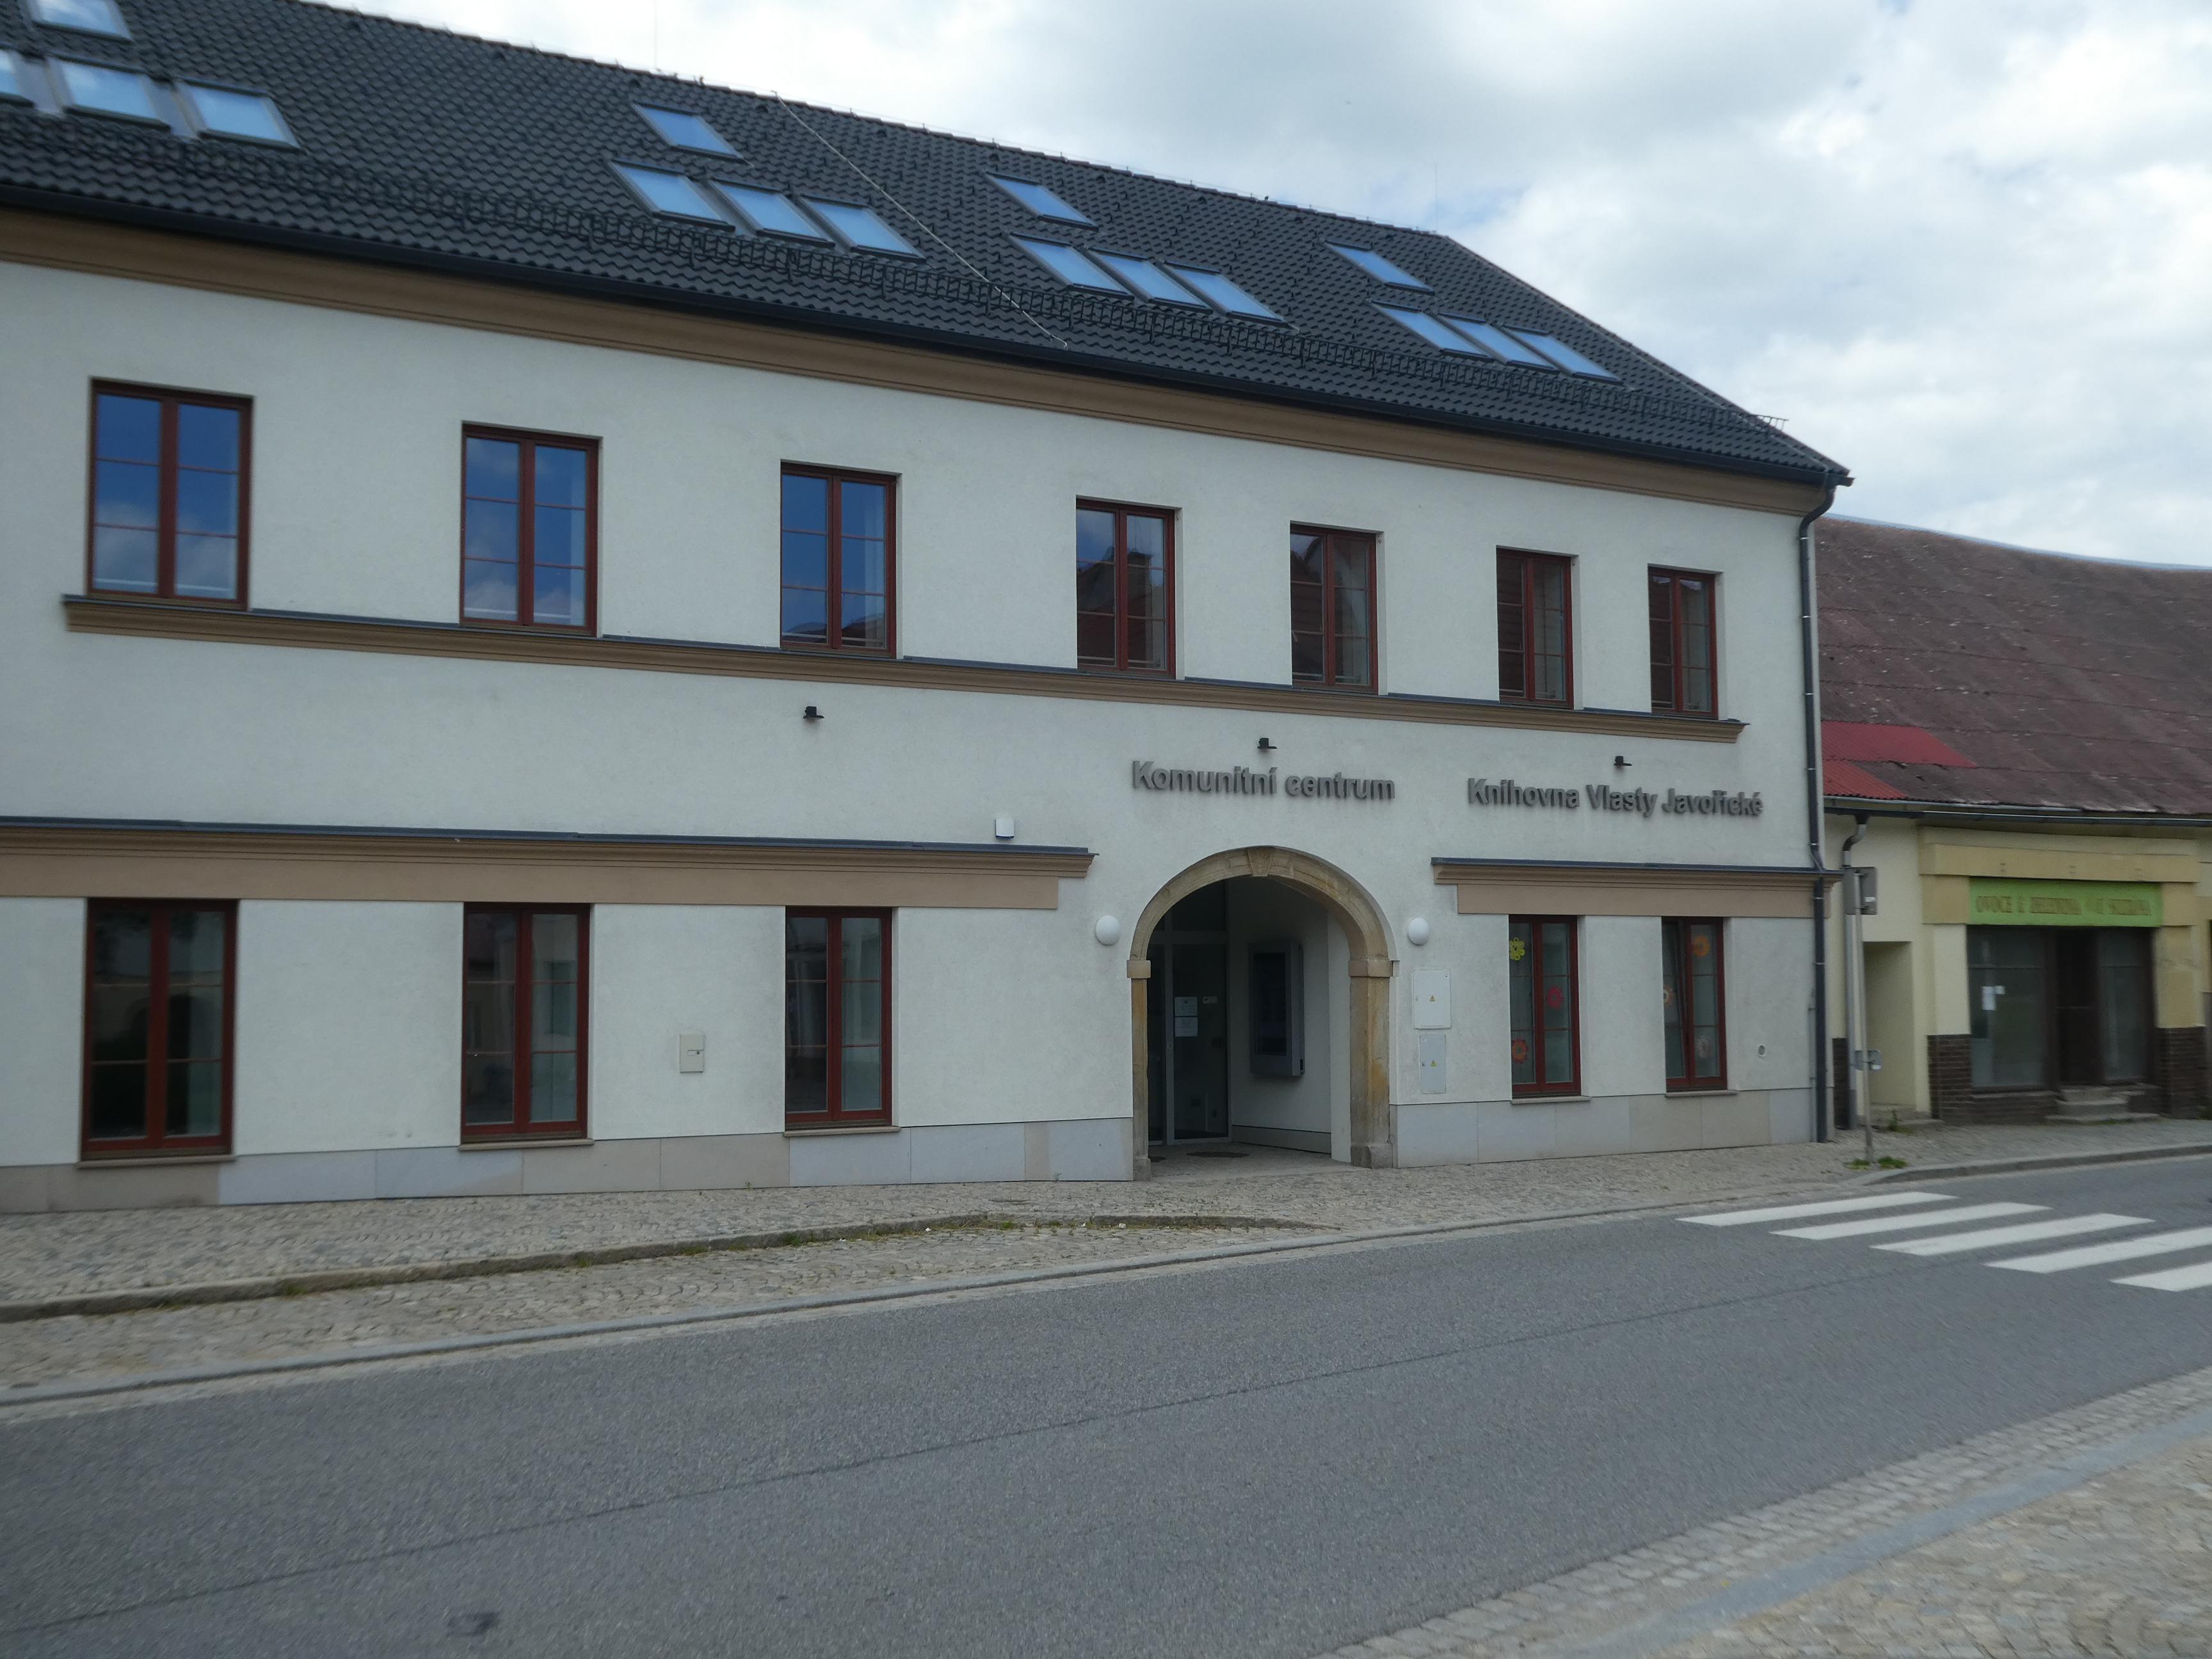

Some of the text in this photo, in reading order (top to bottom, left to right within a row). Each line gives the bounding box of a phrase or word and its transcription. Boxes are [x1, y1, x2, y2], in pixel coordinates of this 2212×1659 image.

[1132, 760, 1395, 799] Komunitní centrum
[1468, 778, 1763, 818] Knihovna Vlasty Javořické
